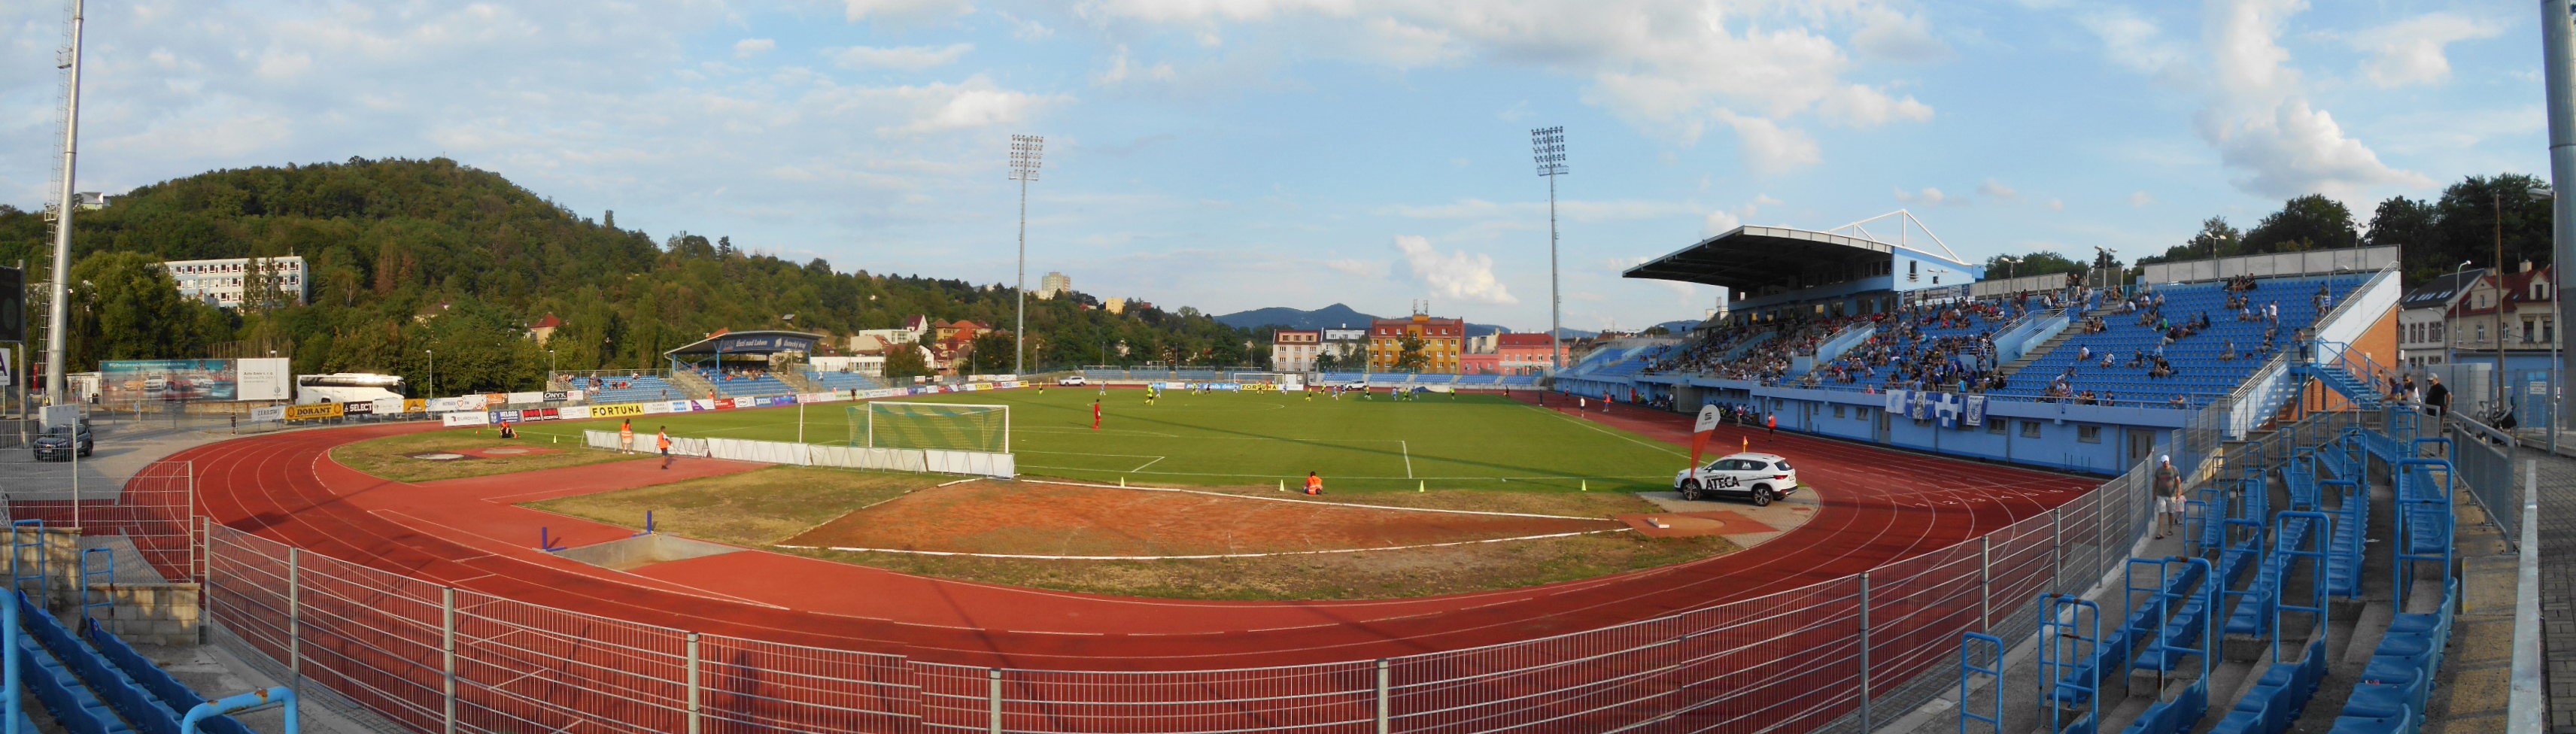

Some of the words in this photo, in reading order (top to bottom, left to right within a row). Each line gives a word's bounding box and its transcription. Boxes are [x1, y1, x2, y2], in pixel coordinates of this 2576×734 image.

[296, 407, 331, 415] DORANT
[349, 402, 372, 412] SELECT
[592, 405, 642, 417] FORTUNA
[1706, 476, 1740, 489] ATECA
